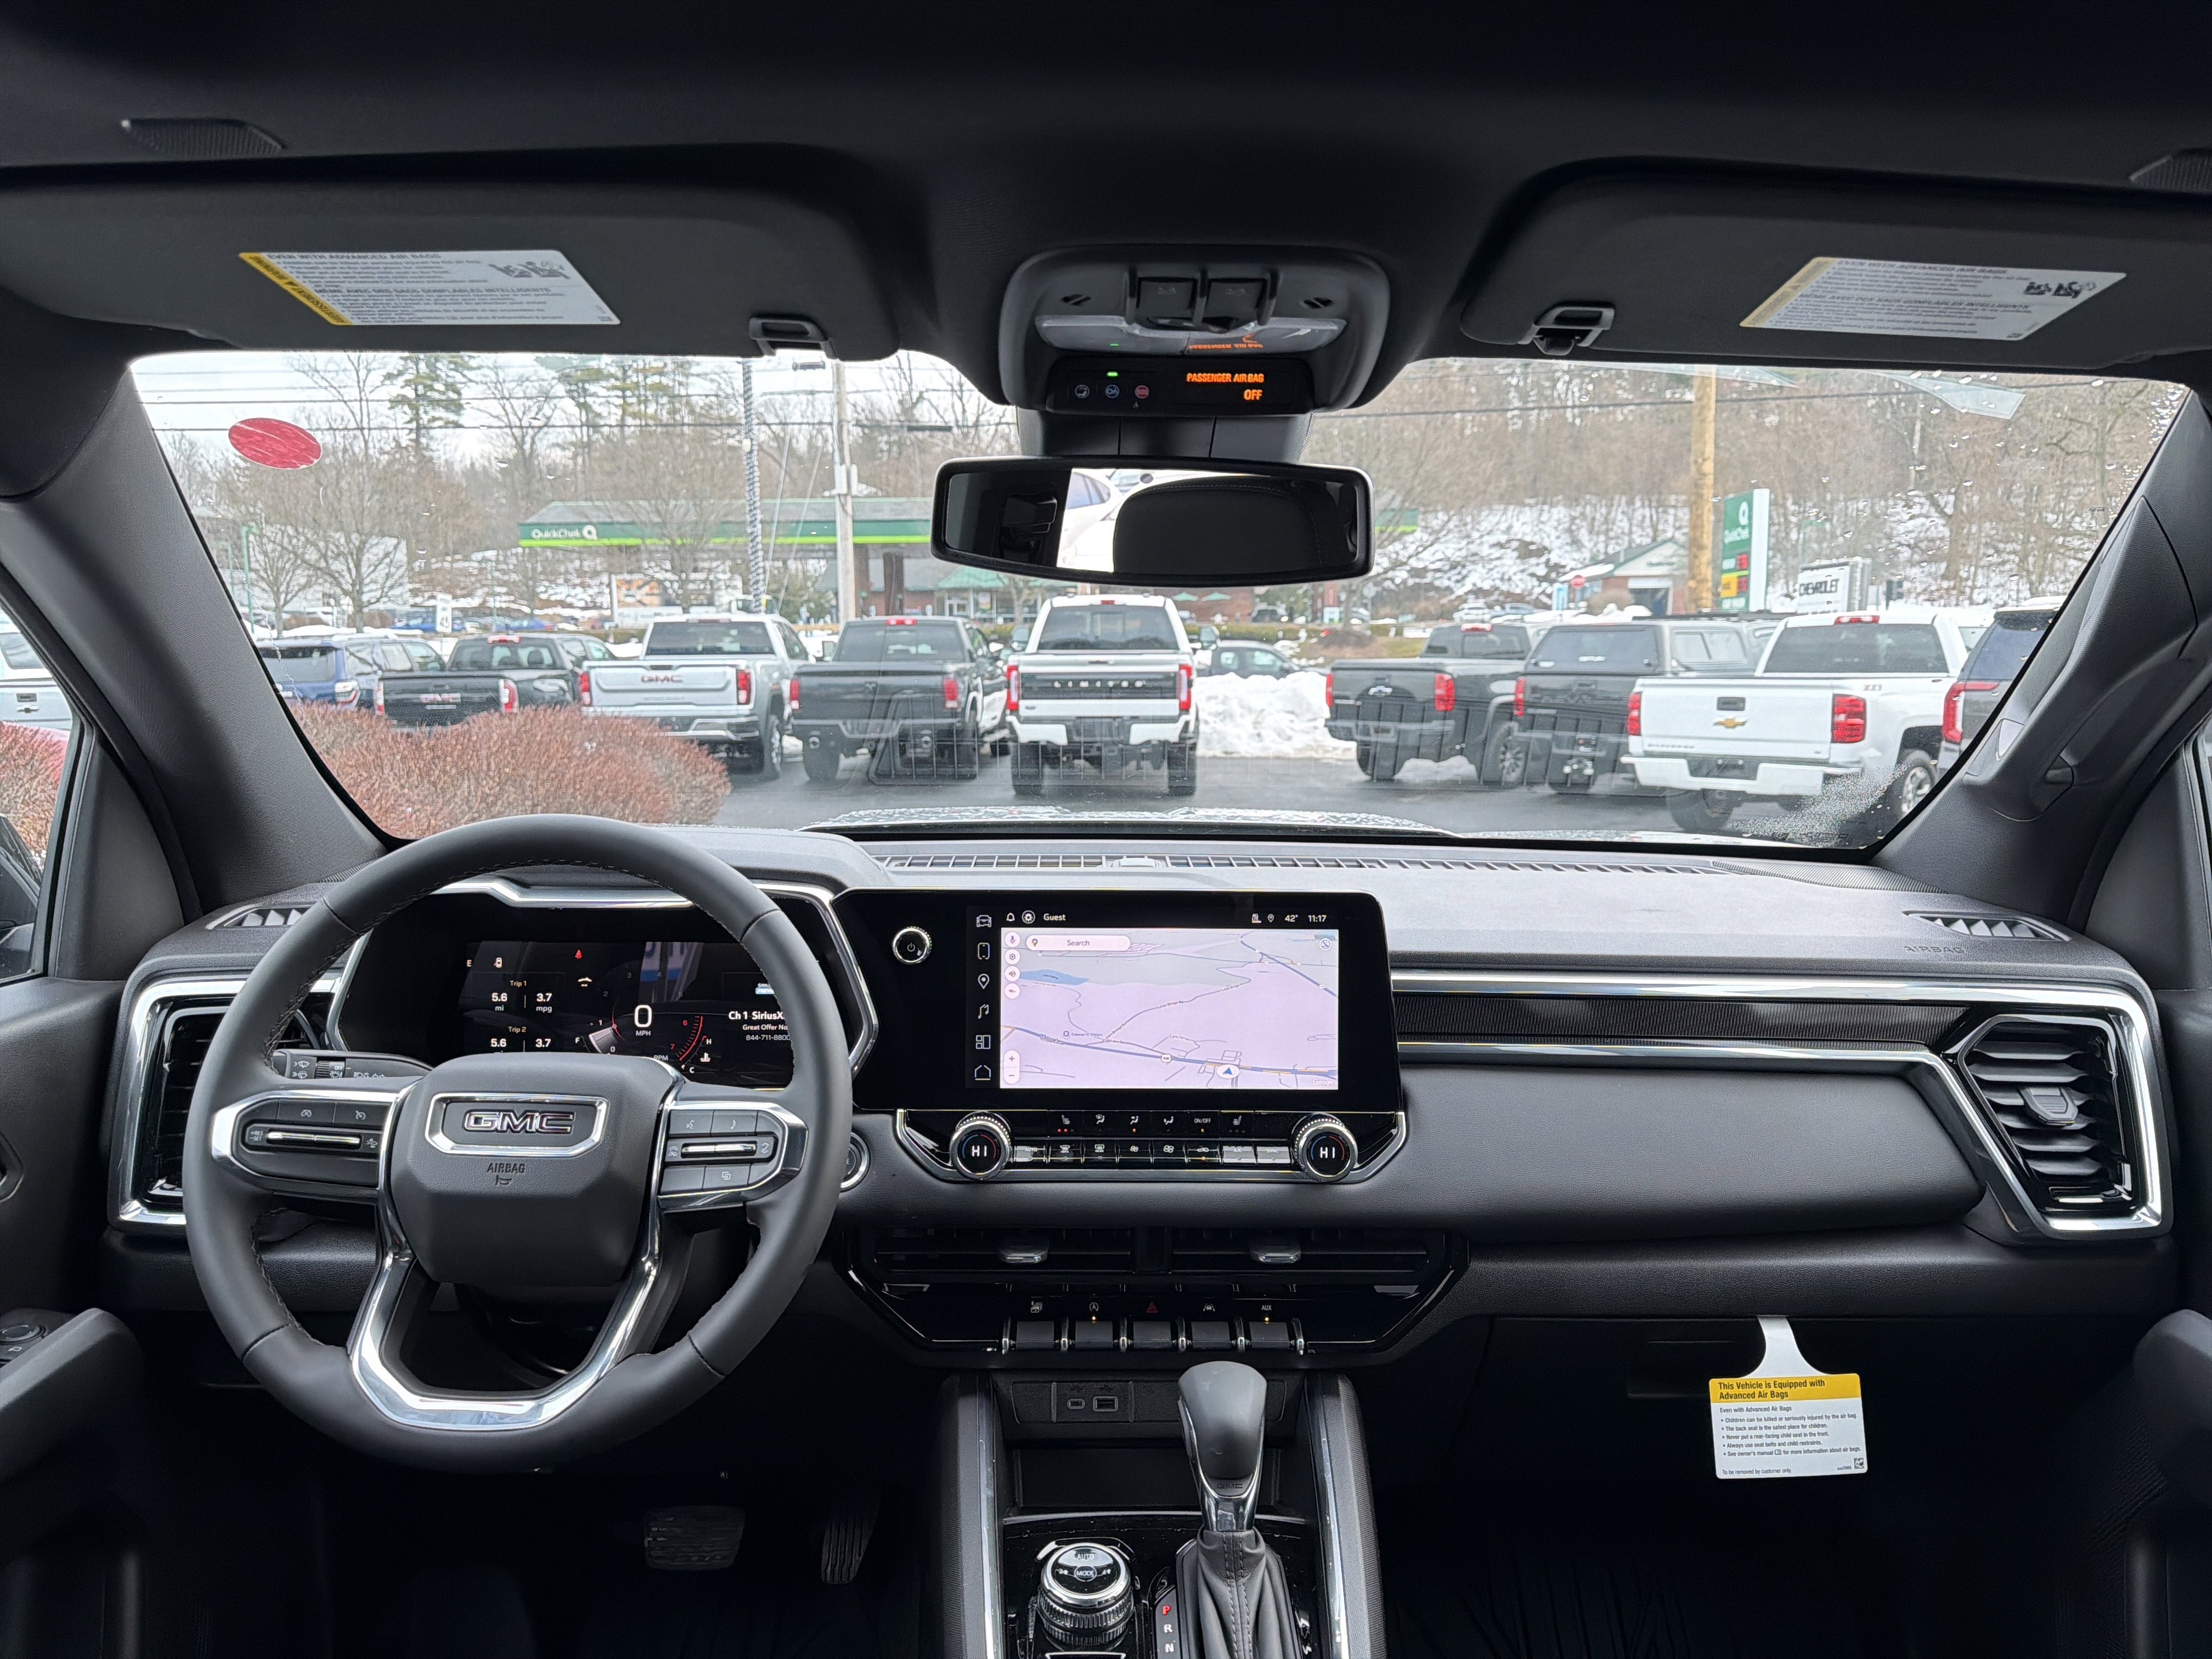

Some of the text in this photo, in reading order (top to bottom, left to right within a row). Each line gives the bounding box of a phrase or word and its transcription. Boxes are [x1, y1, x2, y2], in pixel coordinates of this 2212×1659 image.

[1186, 373, 1232, 383] PASSENGER
[1244, 389, 1262, 400] OFF
[1043, 913, 1066, 921] Guest
[1284, 914, 1299, 922] 42°
[1904, 945, 1965, 954] AIRBAG
[492, 992, 507, 1002] 5.6
[536, 992, 552, 1002] 3.7
[634, 1005, 652, 1028] 0
[728, 1011, 785, 1020] Ch 1 SiriusX
[490, 1039, 507, 1047] 5.6
[535, 1039, 551, 1047] 3.7
[464, 1110, 575, 1134] GMC
[972, 1145, 987, 1157] HI
[1320, 1147, 1335, 1159] HI
[487, 1163, 526, 1174] AIRBAG
[1736, 1381, 1763, 1389] Vehicle
[1765, 1380, 1771, 1389] is
[1774, 1380, 1807, 1390] Equipped
[1719, 1390, 1788, 1400] Advanced Air Bags
[1163, 1605, 1172, 1616] P
[1164, 1624, 1173, 1633] R
[1165, 1643, 1175, 1653] N
